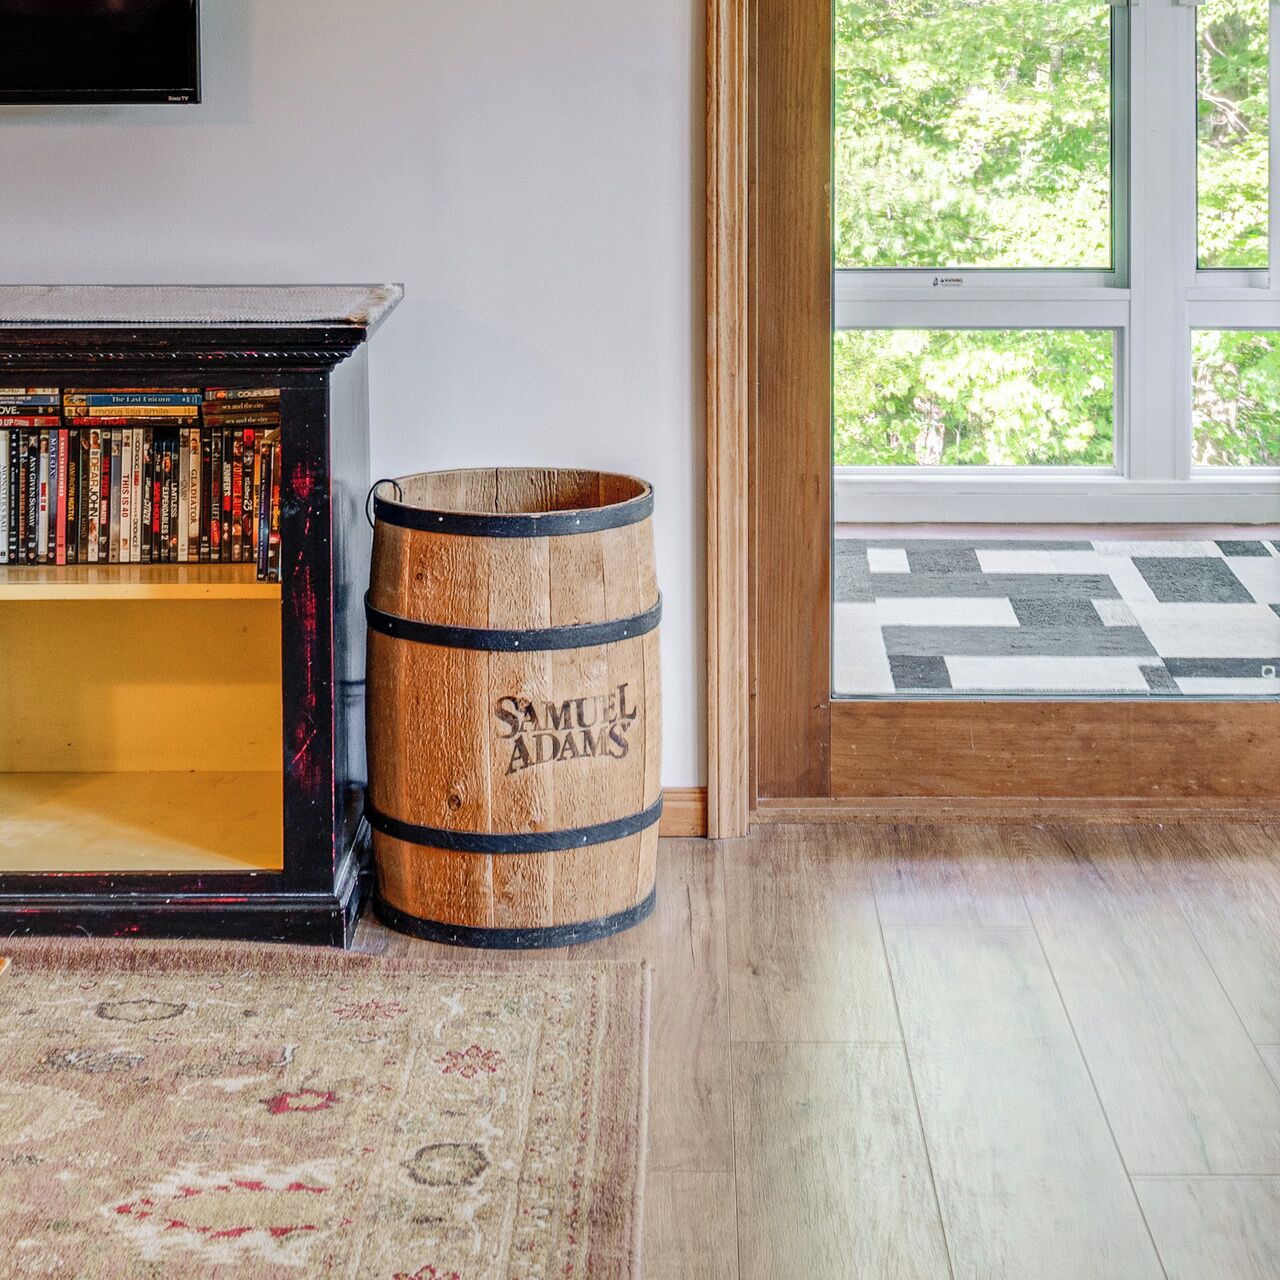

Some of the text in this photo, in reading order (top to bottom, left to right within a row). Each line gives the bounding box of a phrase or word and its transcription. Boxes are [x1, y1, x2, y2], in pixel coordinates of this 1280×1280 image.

[4, 418, 14, 426] UP
[89, 457, 99, 518] DEAR JOHN
[122, 497, 129, 505] IS
[243, 500, 252, 511] 23
[122, 508, 129, 518] 40
[494, 683, 637, 739] SAMUEL
[505, 720, 629, 776] ADAMS
